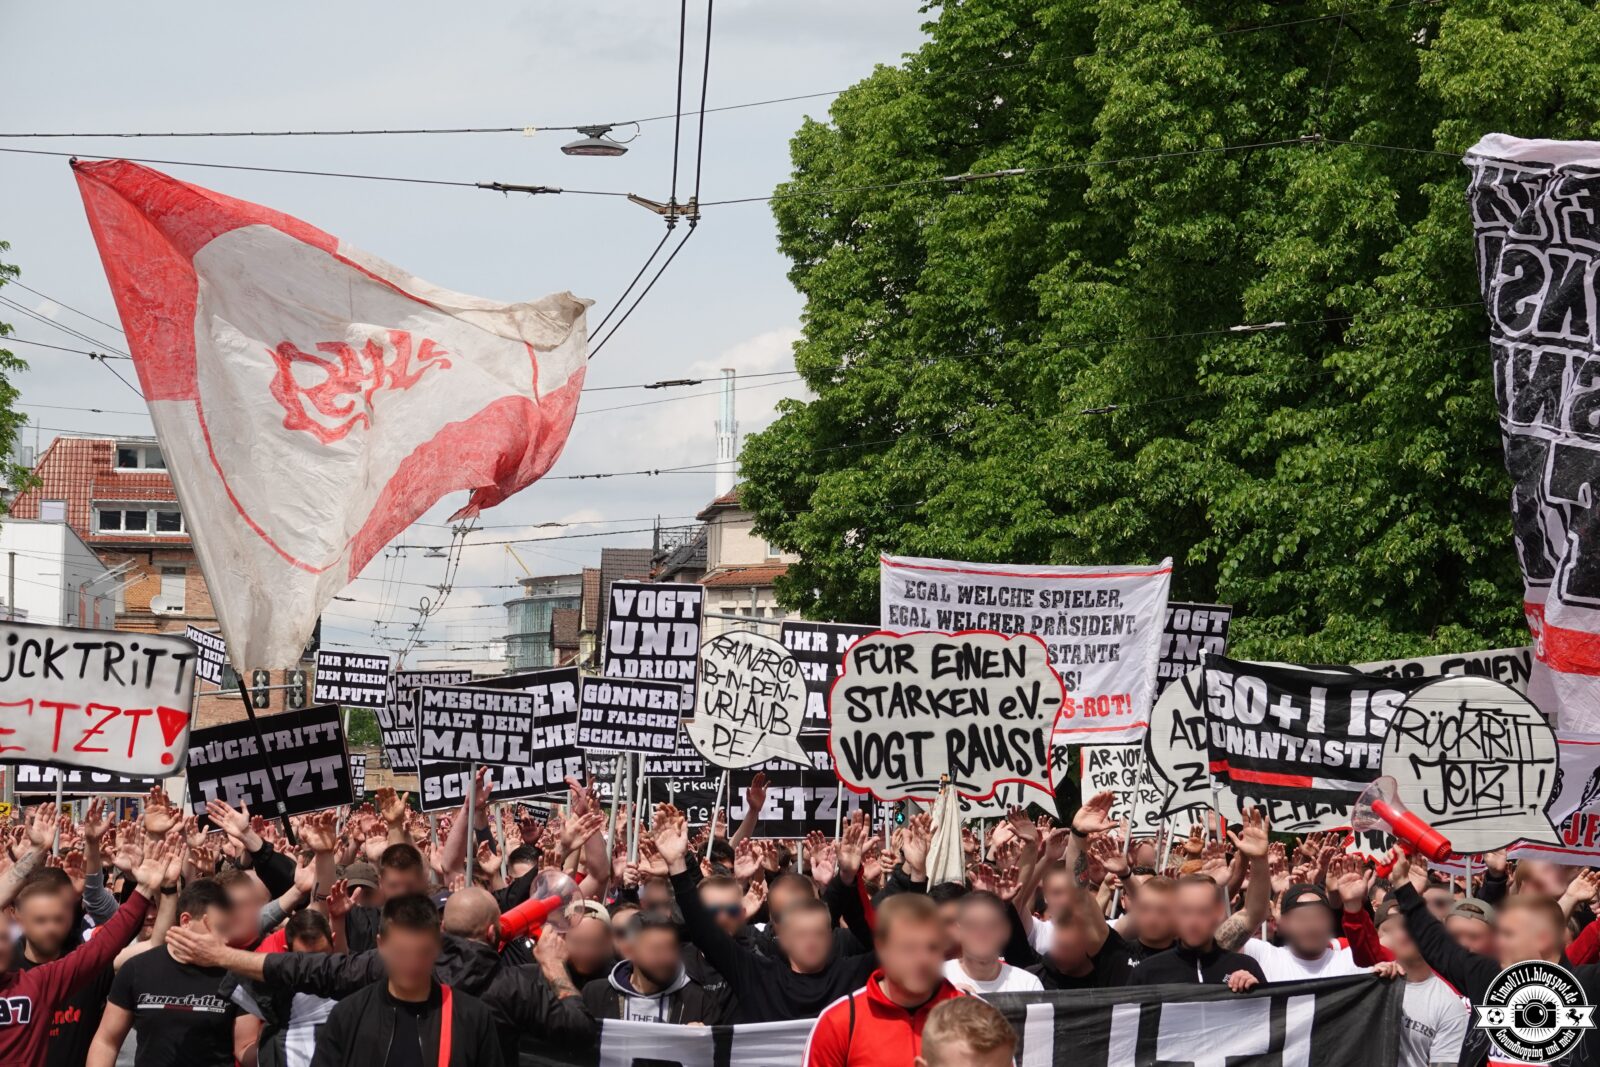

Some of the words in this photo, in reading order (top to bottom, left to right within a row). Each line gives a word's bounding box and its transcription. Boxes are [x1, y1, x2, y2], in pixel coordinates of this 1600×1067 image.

[613, 589, 701, 619] VOGT
[904, 580, 950, 602] EGAL
[958, 585, 1034, 606] WELCHE
[1039, 589, 1123, 610] SPIELER,
[888, 604, 932, 630] EGAL
[937, 610, 1025, 634] WELCHER
[609, 620, 698, 656] UND
[784, 630, 828, 652] IHR
[319, 654, 341, 666] IHR
[345, 657, 388, 670] MACHT
[854, 643, 918, 675] FÜR
[931, 642, 1026, 681] EINEN
[1047, 642, 1120, 665] STANTE
[196, 657, 221, 683] AUL
[317, 670, 341, 681] DEN
[344, 672, 387, 685] VEREIN
[397, 674, 471, 687] MESCHKE
[605, 658, 696, 679] ADRION
[802, 661, 828, 681] EN
[316, 685, 386, 703] KAPUTT
[424, 690, 533, 714] MESCHKE
[583, 683, 679, 710] GÖNNER
[844, 681, 990, 723] STARKEN
[423, 710, 477, 729] HALT
[482, 714, 531, 733] DEIN
[581, 708, 604, 722] DU
[607, 710, 678, 729] FALSCHE
[705, 690, 792, 736] URLAUB
[0, 697, 192, 766] ETZT!
[188, 720, 340, 767] RÜCKTRITT
[579, 727, 675, 750] SCHLANGE
[422, 729, 530, 763] MAUL
[839, 730, 935, 782] VOGT
[945, 723, 1050, 780] RAUS!
[1091, 771, 1120, 789] FÜR
[731, 787, 868, 820] JETZT
[1404, 1017, 1437, 1039] TERS
